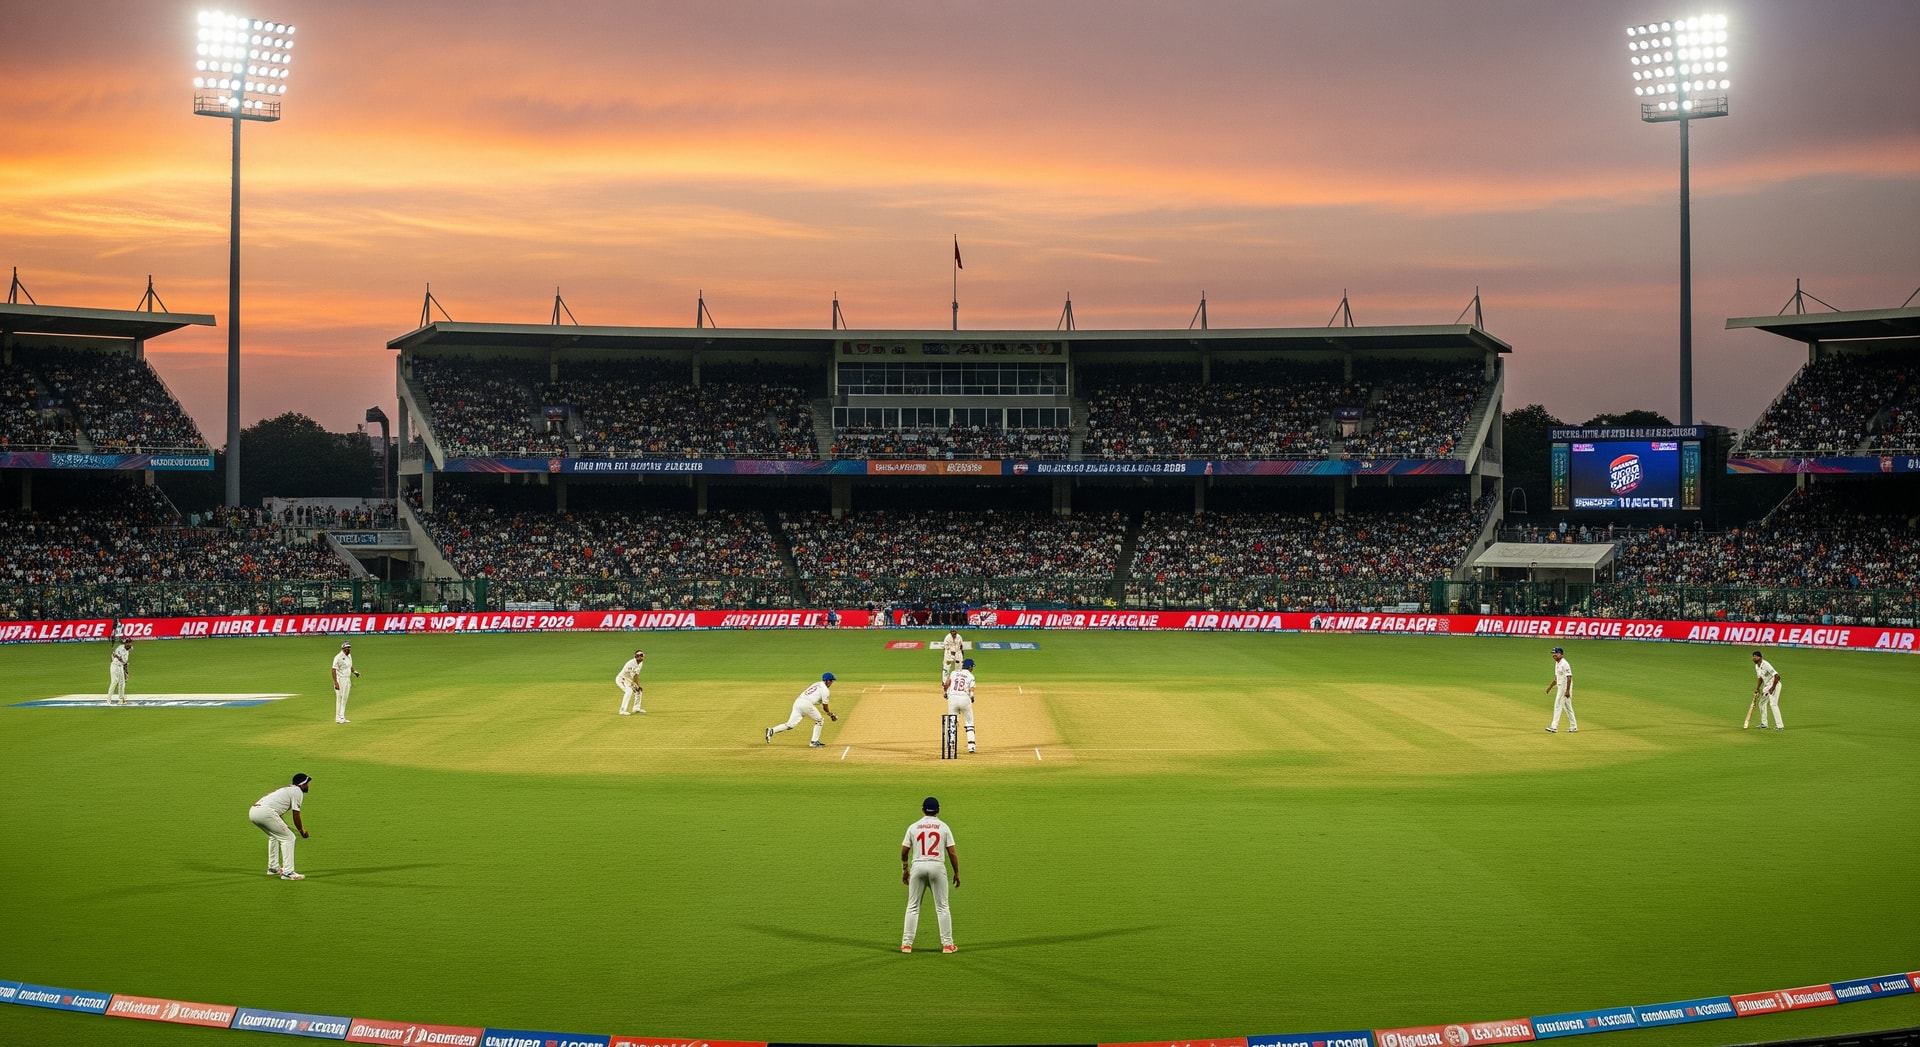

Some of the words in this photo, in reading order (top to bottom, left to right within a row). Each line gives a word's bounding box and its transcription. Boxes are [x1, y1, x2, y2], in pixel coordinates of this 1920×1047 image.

[180, 622, 208, 635] AIR
[538, 615, 575, 628] 2026
[600, 613, 637, 628] AIR
[639, 613, 696, 627] INDIA
[1185, 614, 1220, 629] AIR
[1220, 614, 1282, 629] INDIA
[1554, 620, 1622, 636] LEAGUE
[1625, 623, 1664, 638] 2026
[1688, 626, 1720, 641] AIR
[1778, 628, 1850, 646] LEAGUE
[1875, 631, 1915, 650] AIR
[916, 831, 941, 857] 12
